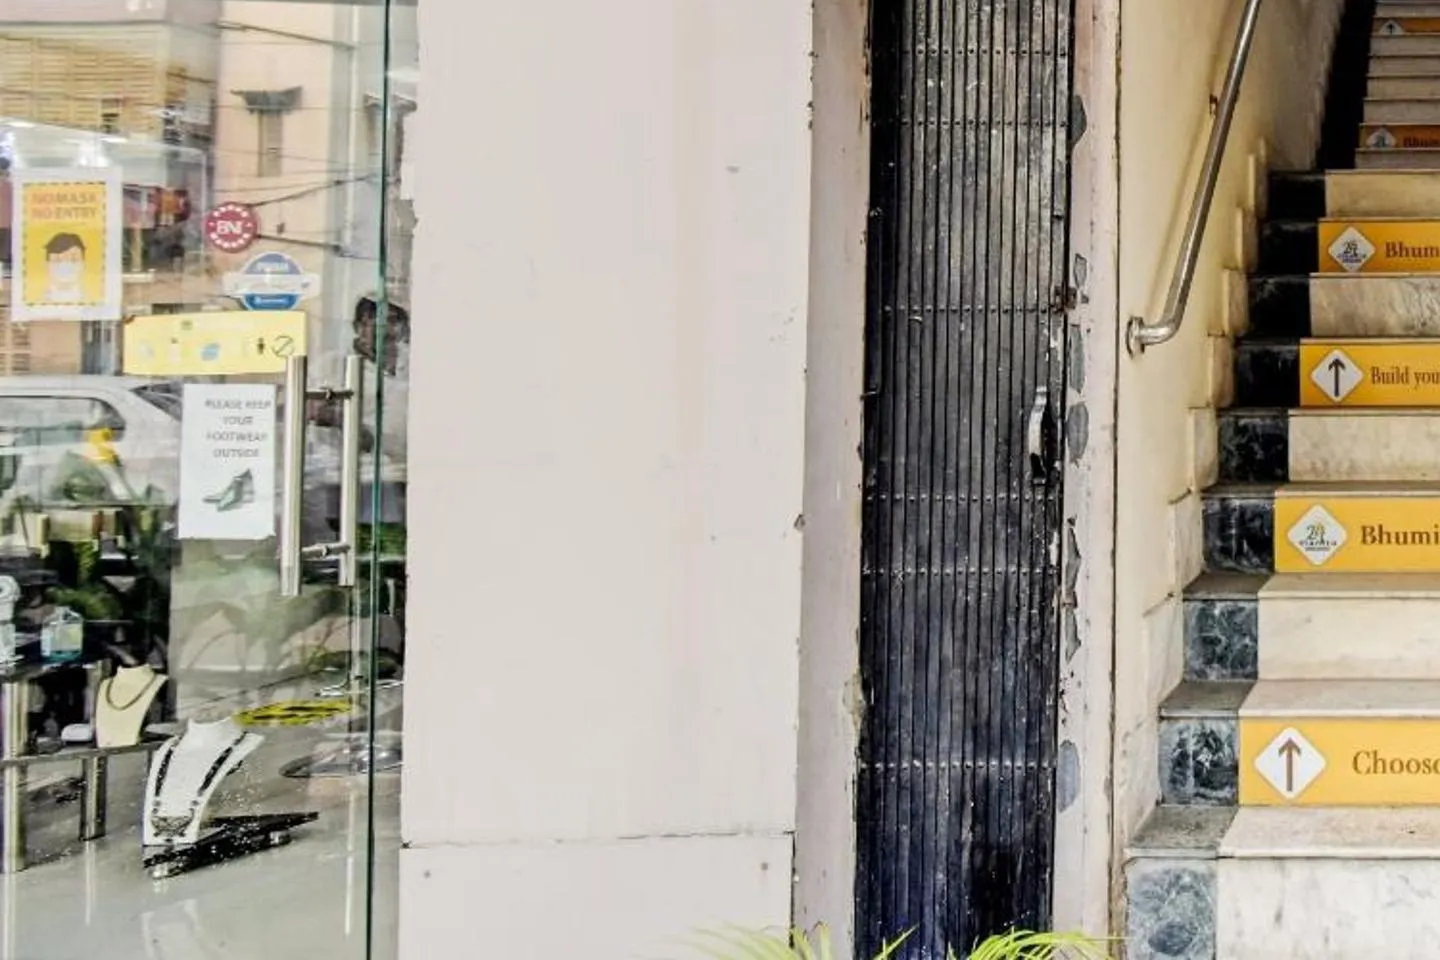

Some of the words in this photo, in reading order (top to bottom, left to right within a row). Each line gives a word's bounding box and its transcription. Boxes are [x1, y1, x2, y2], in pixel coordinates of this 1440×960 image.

[31, 192, 54, 204] NO
[56, 192, 97, 204] MASK
[31, 207, 53, 219] NO
[55, 207, 97, 219] ENTRY
[1370, 365, 1410, 385] Build
[212, 447, 259, 458] OUTSIDE
[1360, 524, 1440, 546] Bhumi
